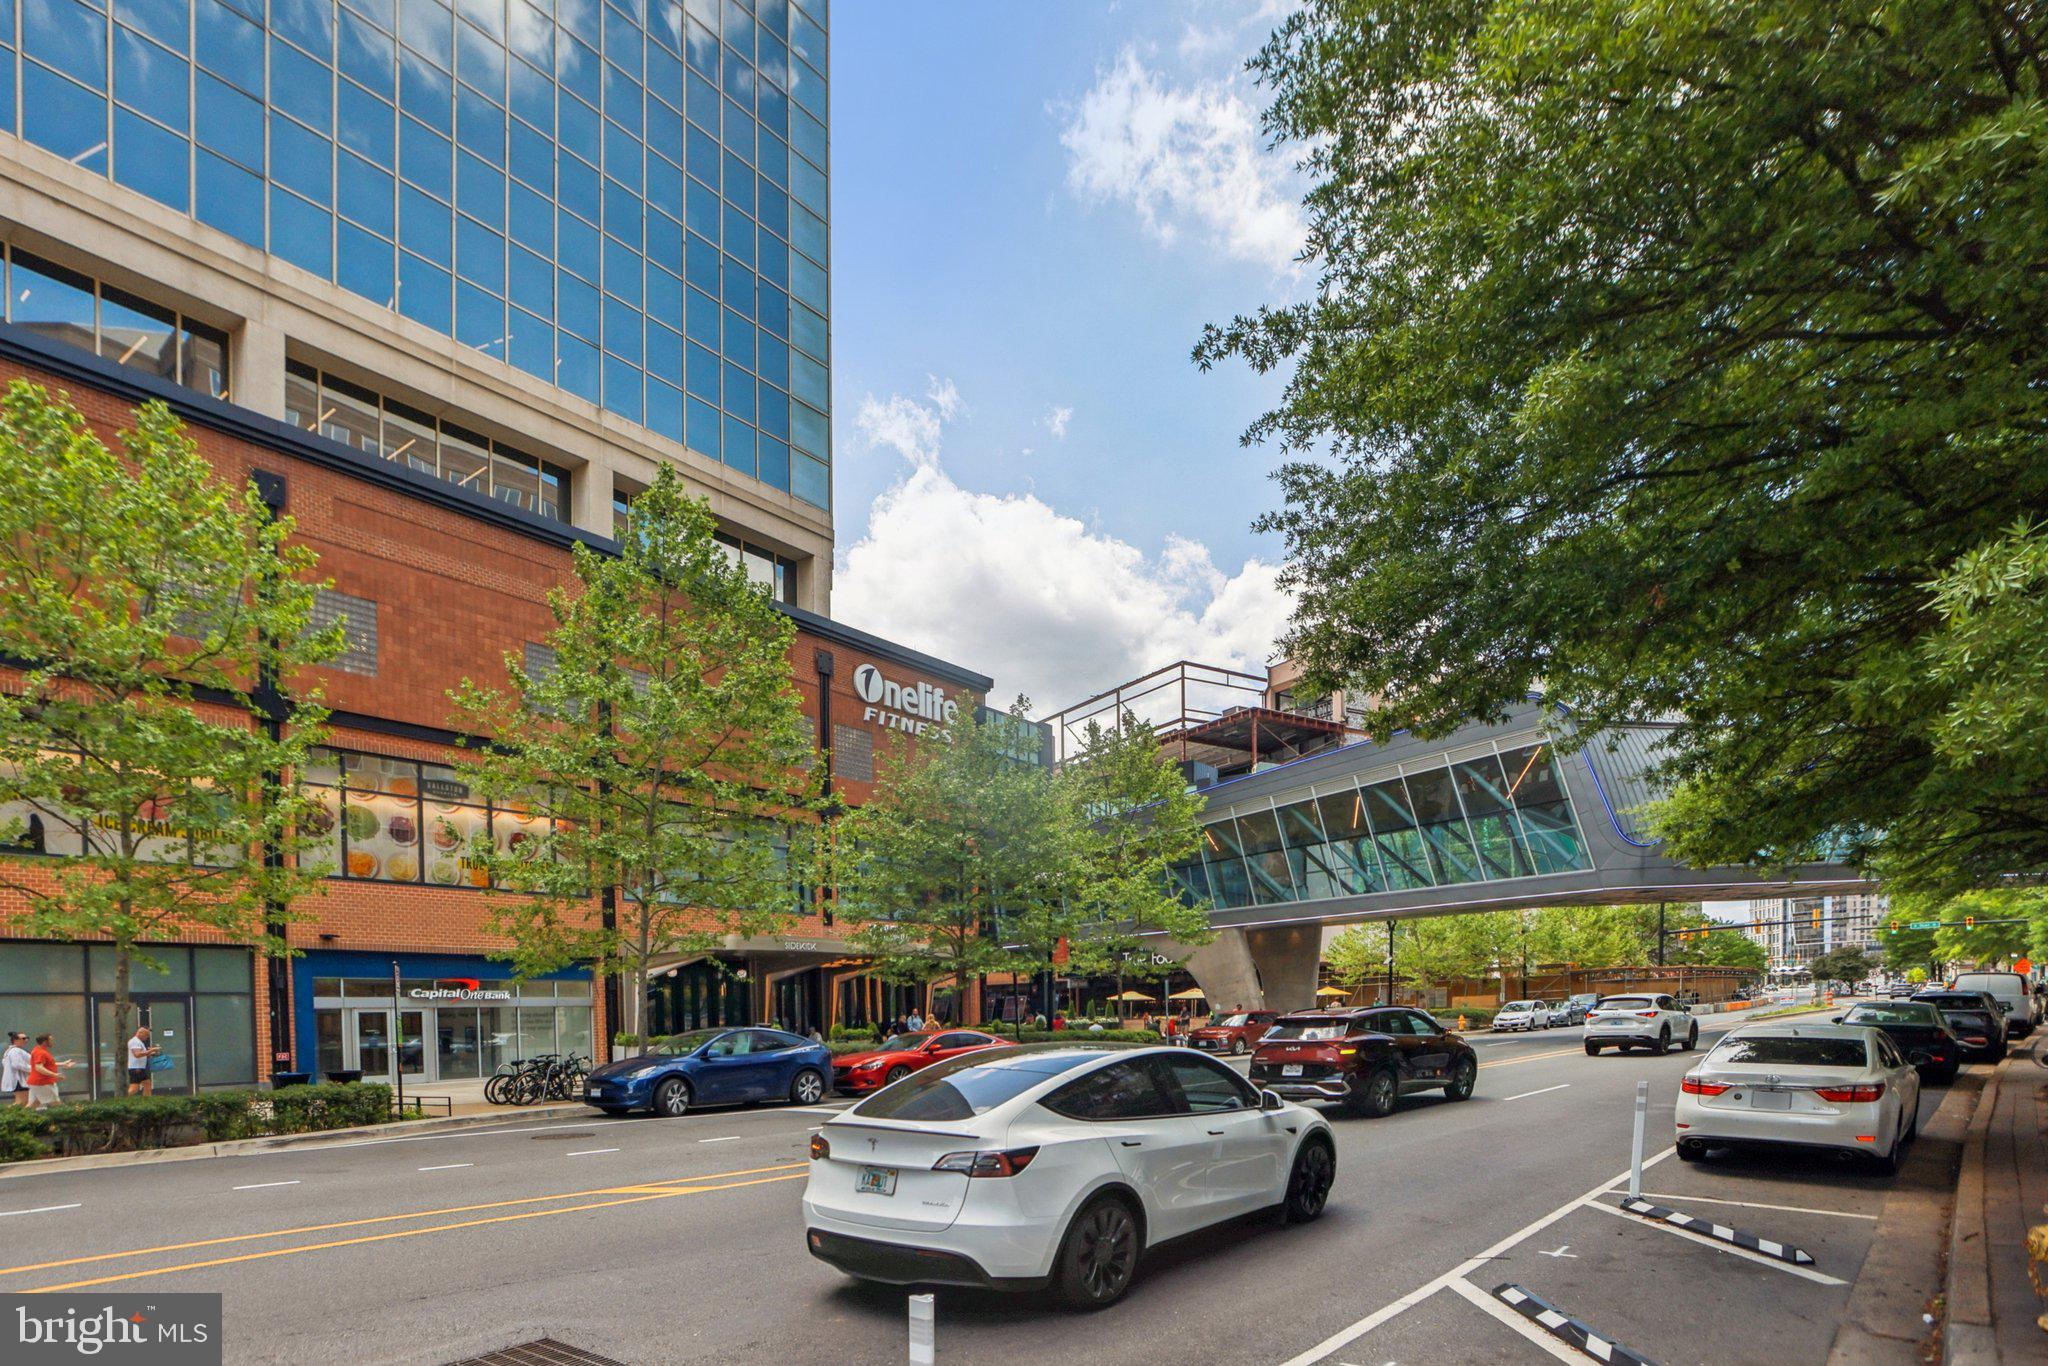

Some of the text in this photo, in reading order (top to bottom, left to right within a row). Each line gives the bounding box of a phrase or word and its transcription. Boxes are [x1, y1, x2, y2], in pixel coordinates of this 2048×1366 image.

[853, 663, 959, 725] Onelife
[410, 988, 512, 1001] Capital One Bank
